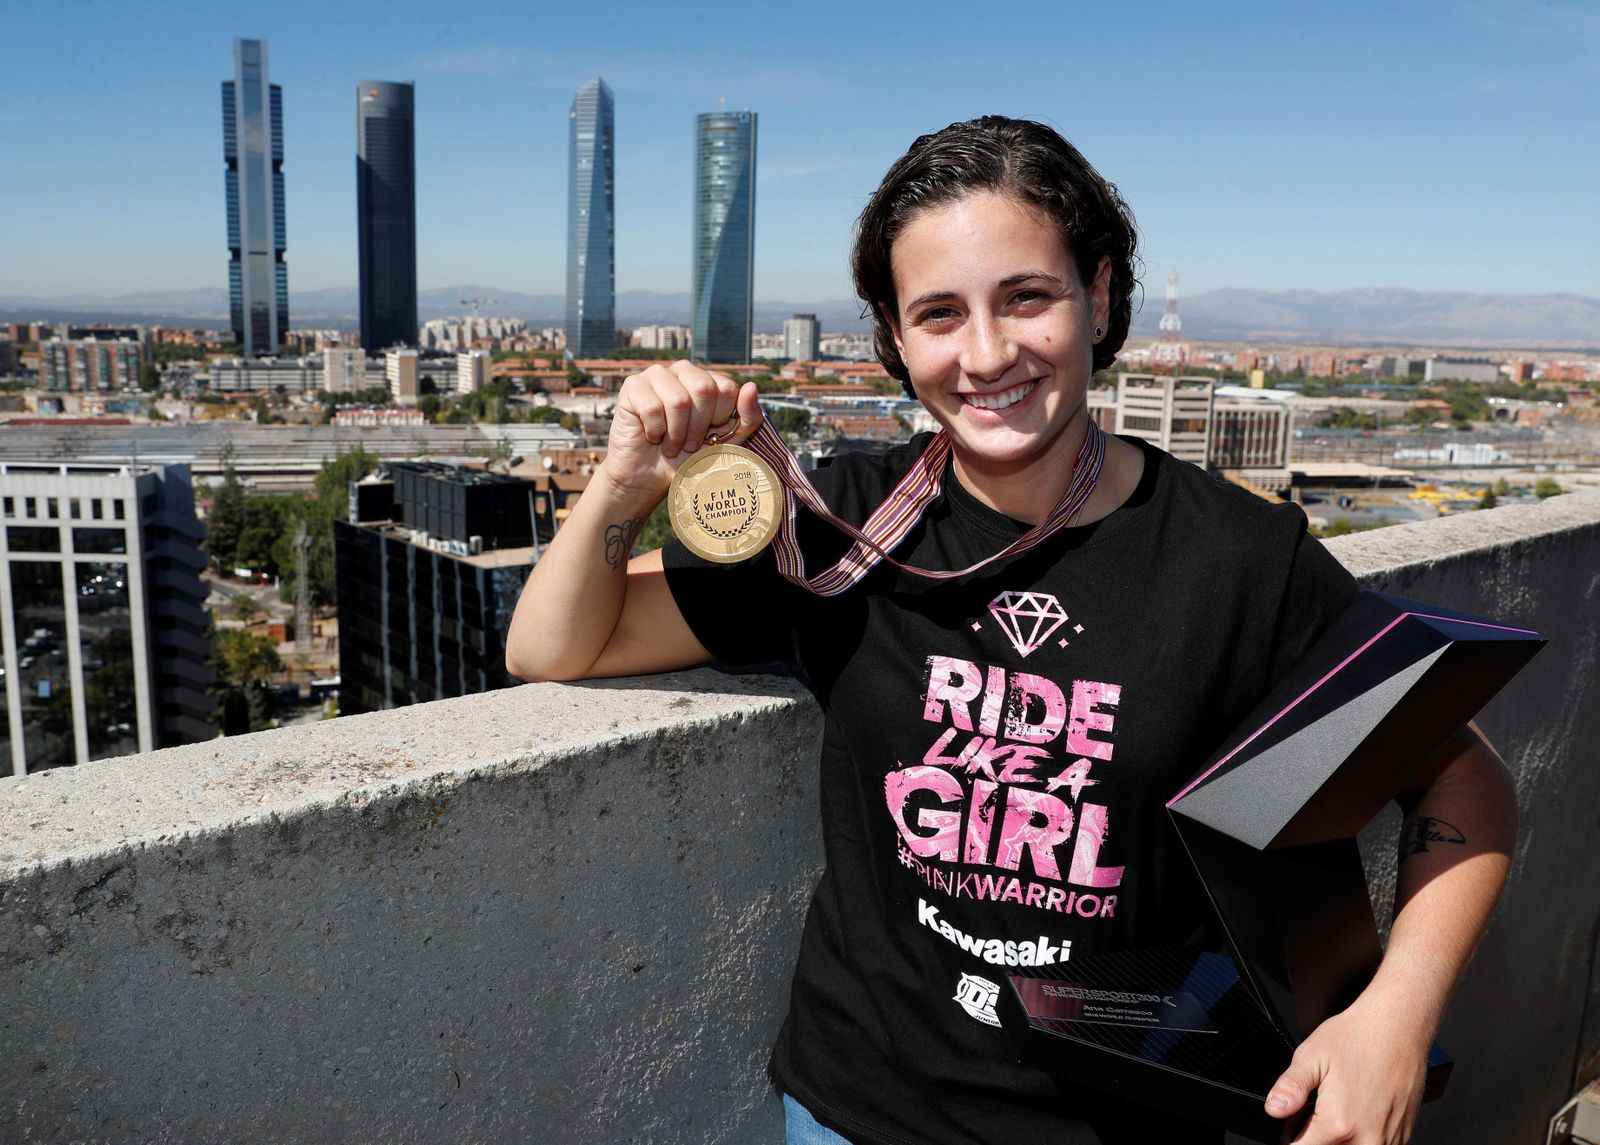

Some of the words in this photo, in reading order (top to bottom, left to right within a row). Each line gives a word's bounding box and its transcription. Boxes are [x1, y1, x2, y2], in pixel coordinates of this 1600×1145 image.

[734, 471, 751, 480] 2018
[711, 488, 736, 501] FIM
[704, 497, 746, 512] WORLD
[705, 507, 747, 519] CHAMPION
[920, 655, 1122, 761] RIDE
[923, 727, 1052, 783] LIKE
[1047, 757, 1100, 803] A
[884, 763, 1126, 888] GIRL
[897, 846, 1119, 918] #PINKWARRIOR
[918, 897, 1072, 967] Kawasaki
[1042, 984, 1161, 1003] SUPERSPORT300
[1105, 1006, 1153, 1016] Carrasco
